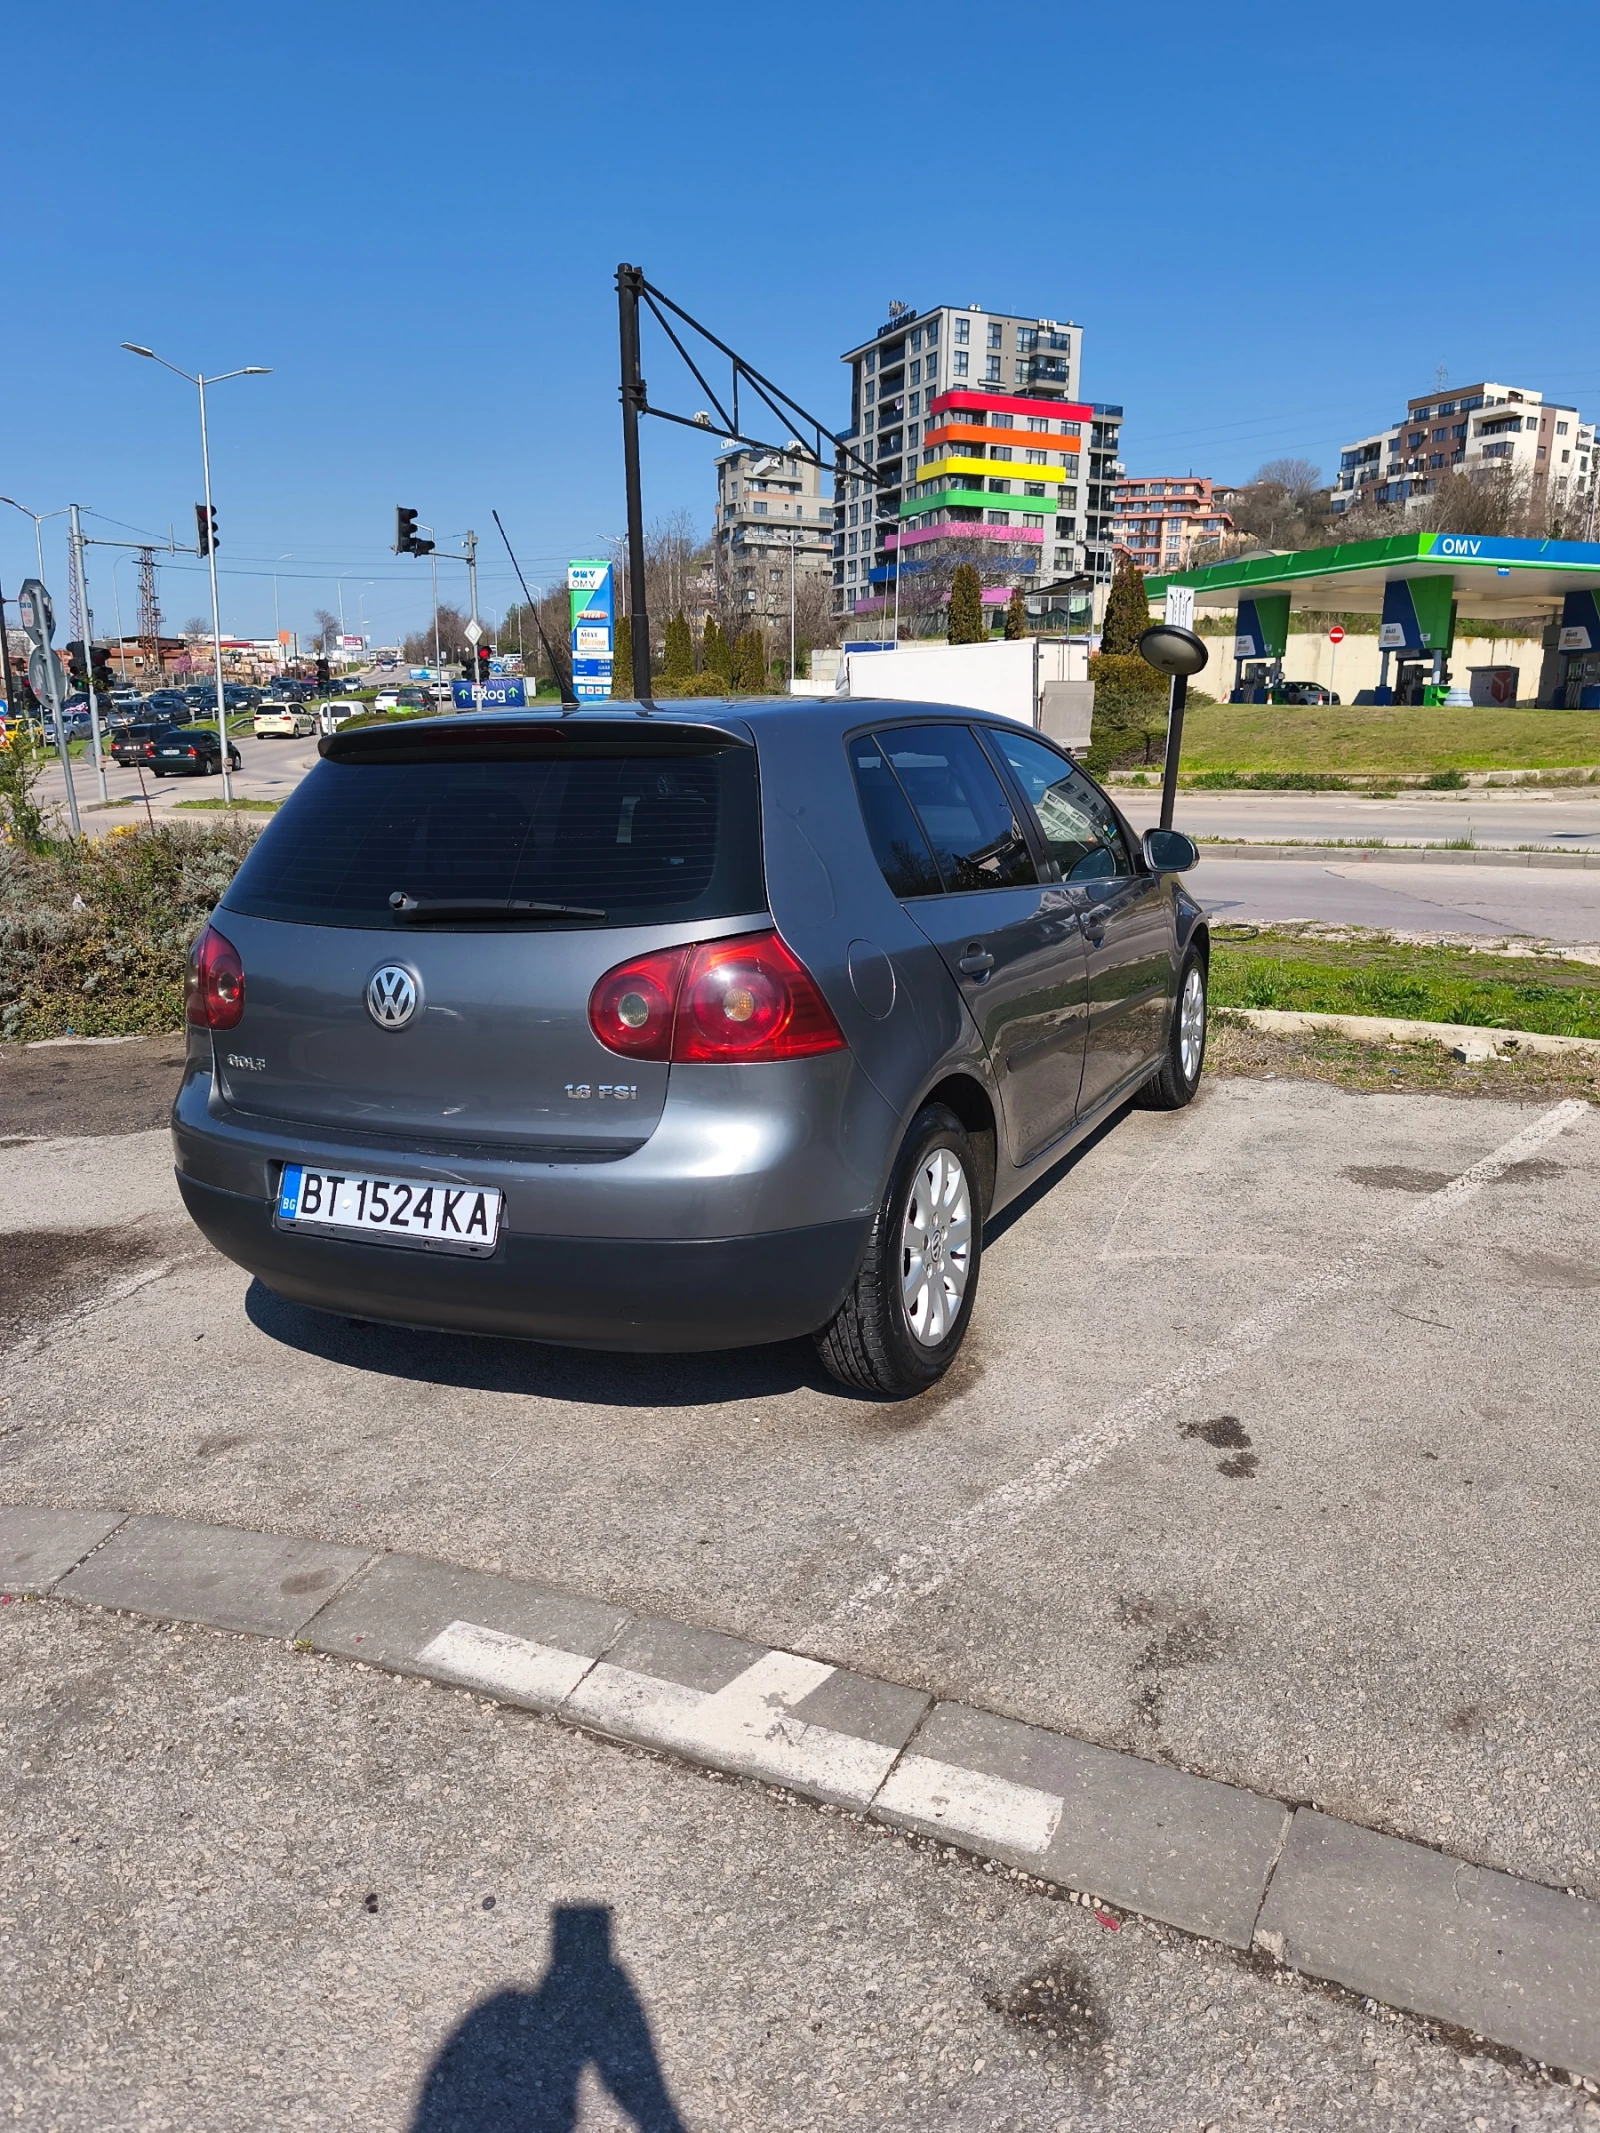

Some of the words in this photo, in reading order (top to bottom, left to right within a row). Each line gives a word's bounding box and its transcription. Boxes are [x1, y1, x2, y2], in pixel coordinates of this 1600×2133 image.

[1442, 538, 1481, 555] OMV
[572, 580, 596, 588] OMV
[227, 1053, 266, 1071] GOLF
[282, 1197, 296, 1210] BG
